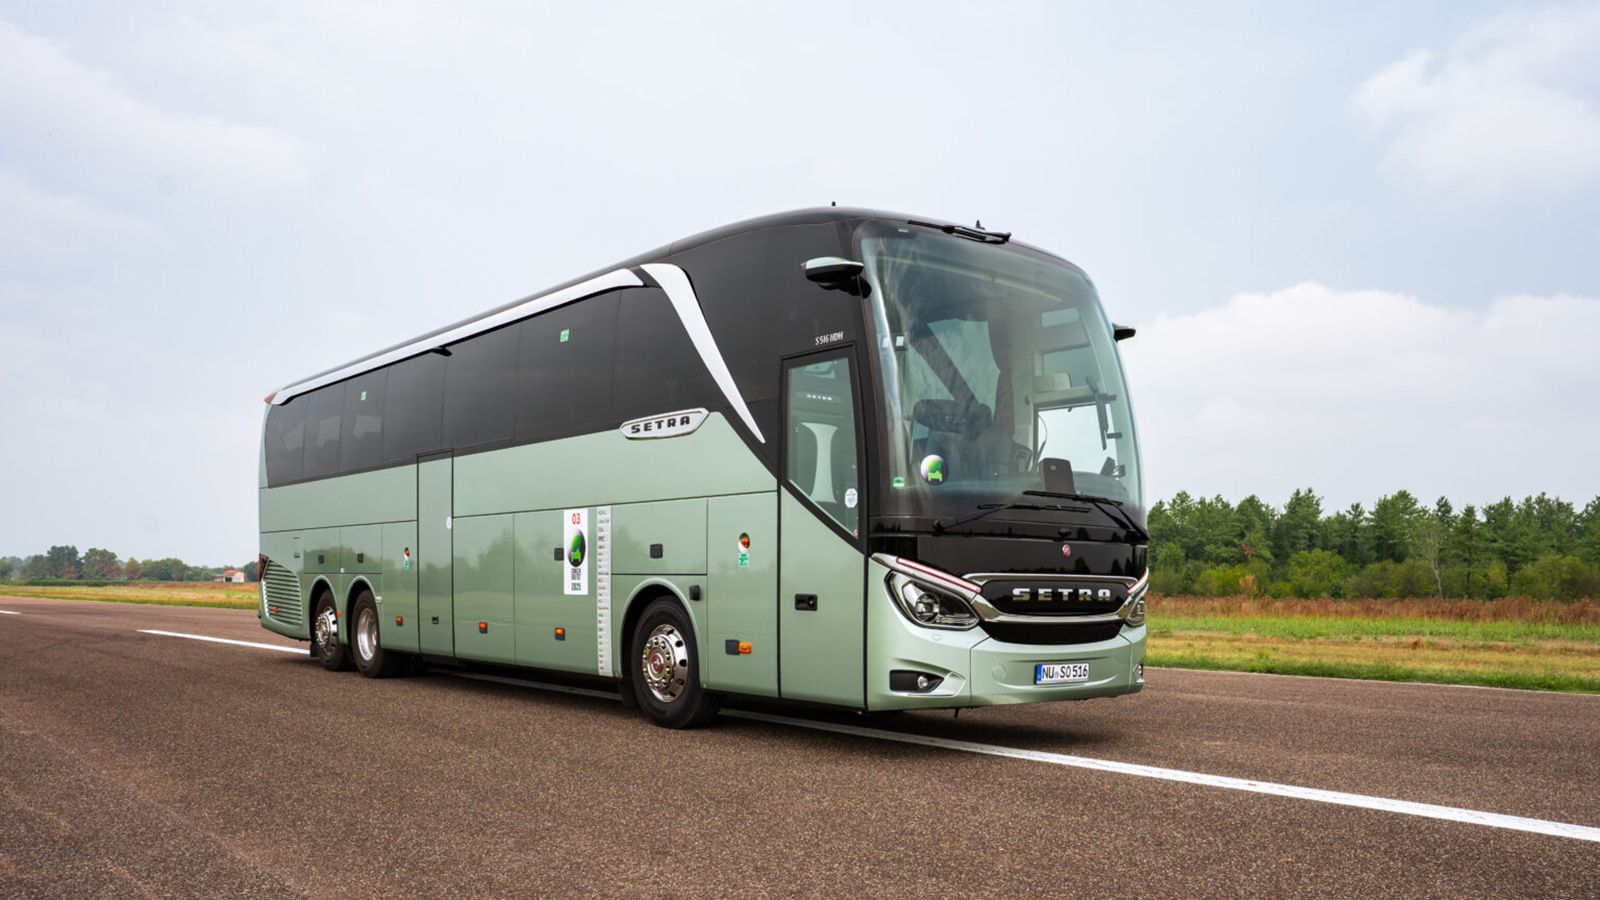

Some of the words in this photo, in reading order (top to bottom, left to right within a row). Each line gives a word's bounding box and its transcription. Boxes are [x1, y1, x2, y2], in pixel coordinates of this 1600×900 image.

[631, 416, 690, 434] SETRA
[571, 512, 581, 525] 03
[1012, 588, 1111, 601] SETRA
[1042, 665, 1055, 679] NU
[1072, 664, 1088, 678] 516
